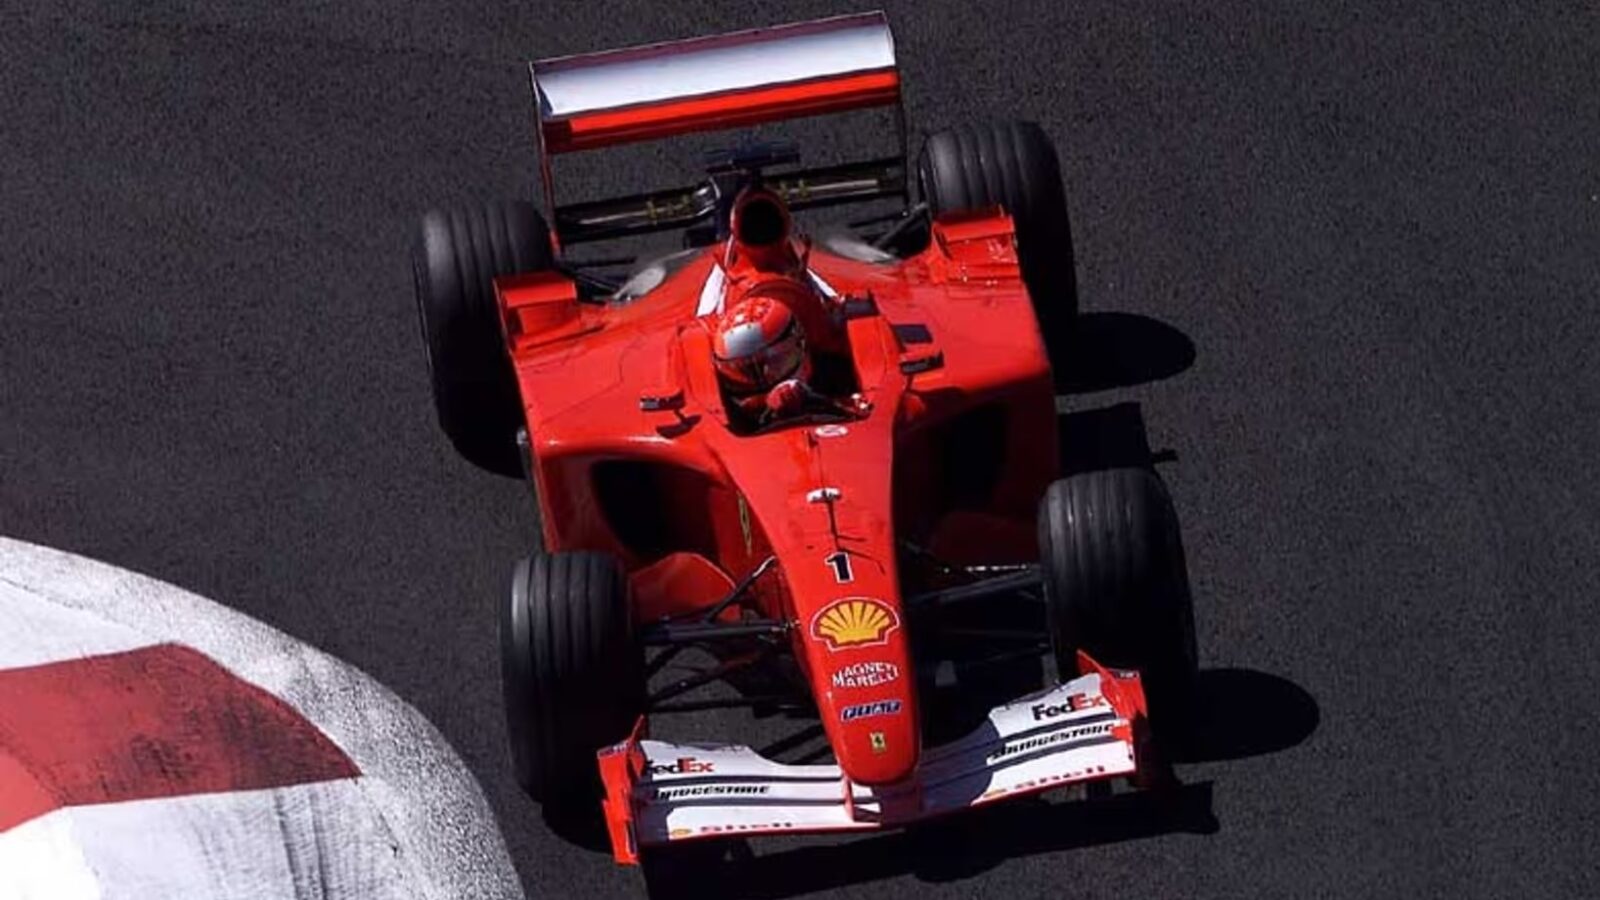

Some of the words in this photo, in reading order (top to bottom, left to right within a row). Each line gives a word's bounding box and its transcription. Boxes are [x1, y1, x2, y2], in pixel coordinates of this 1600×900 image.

[825, 552, 854, 583] 1
[1032, 693, 1105, 720] FedEx
[656, 785, 768, 800] RIDGESTONE
